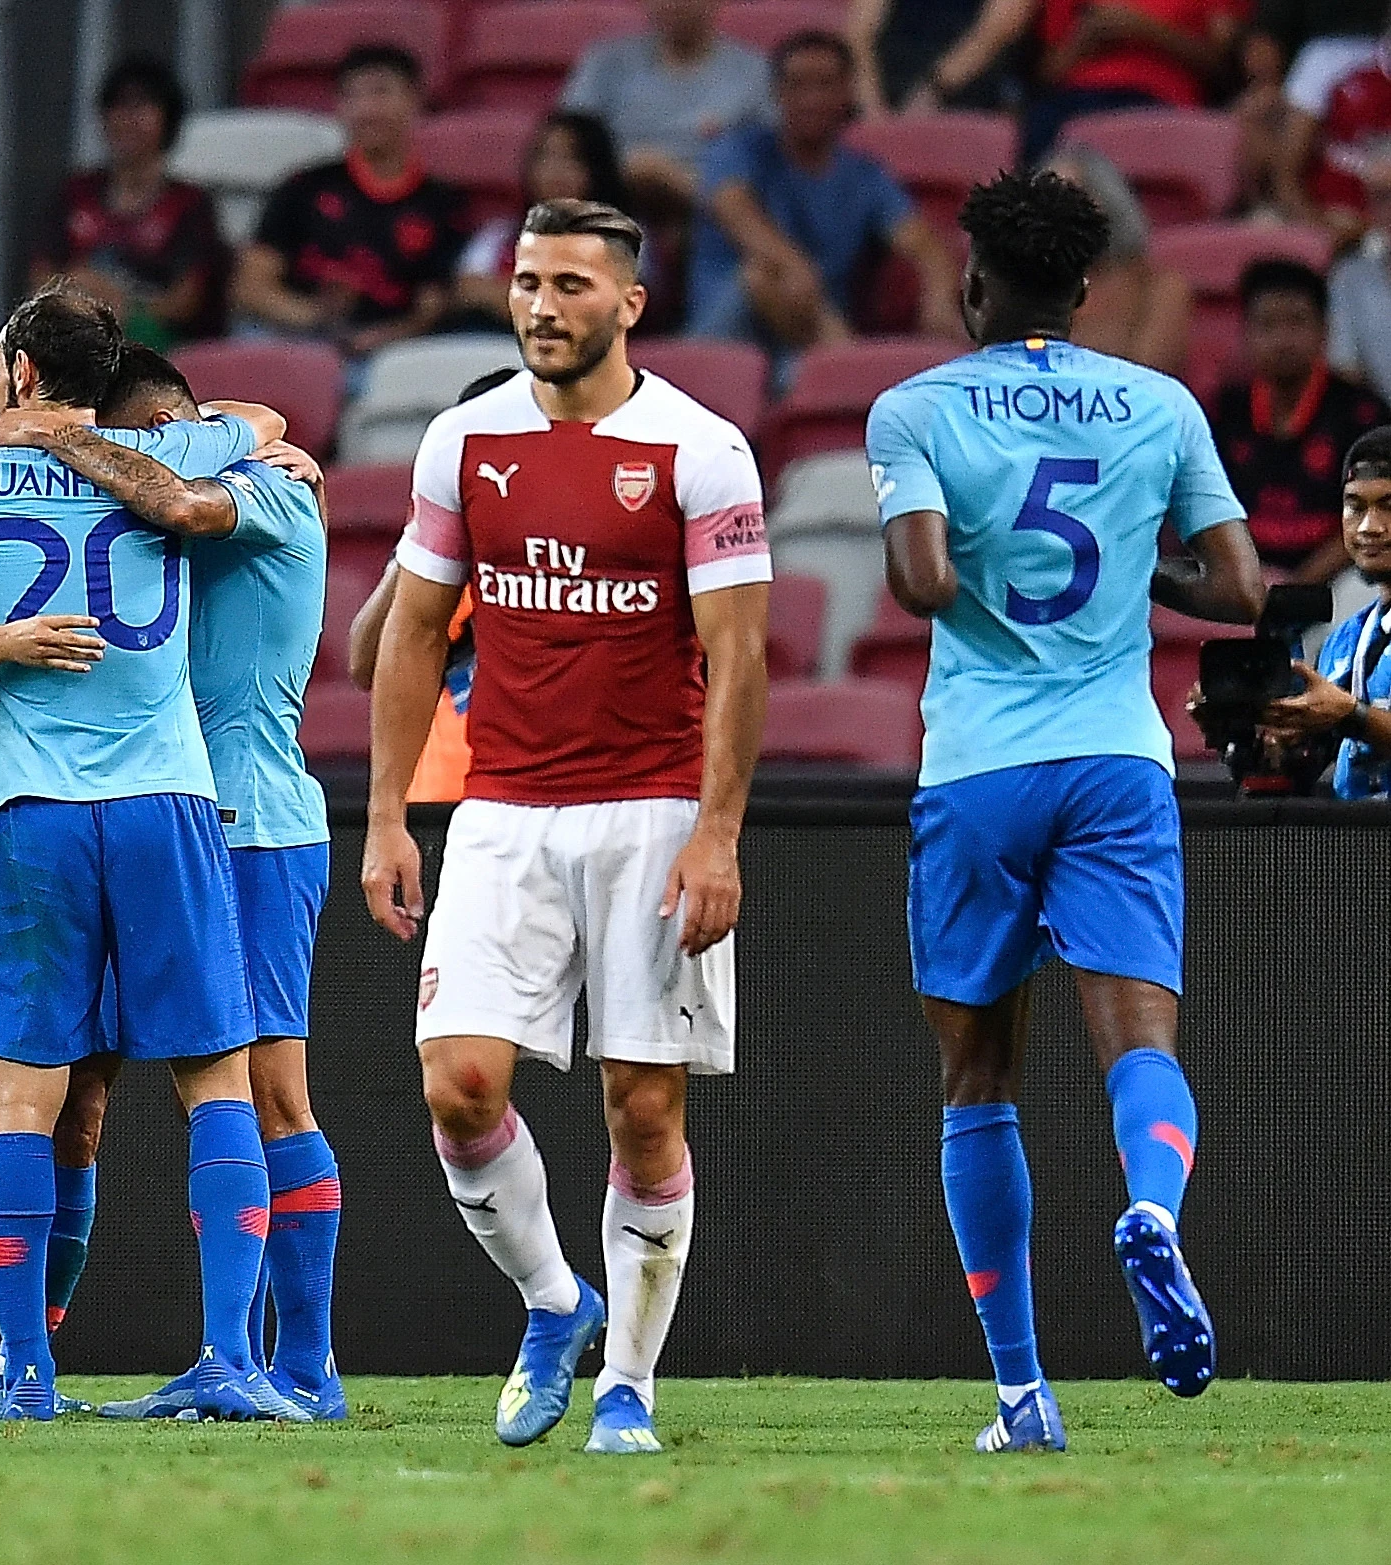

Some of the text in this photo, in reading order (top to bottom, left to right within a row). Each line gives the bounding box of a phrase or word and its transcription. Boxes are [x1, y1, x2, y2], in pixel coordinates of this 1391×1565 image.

[963, 384, 1132, 423] THOMAS
[525, 537, 586, 576] Fly
[1005, 457, 1100, 625] 5
[477, 562, 659, 614] Emirates
